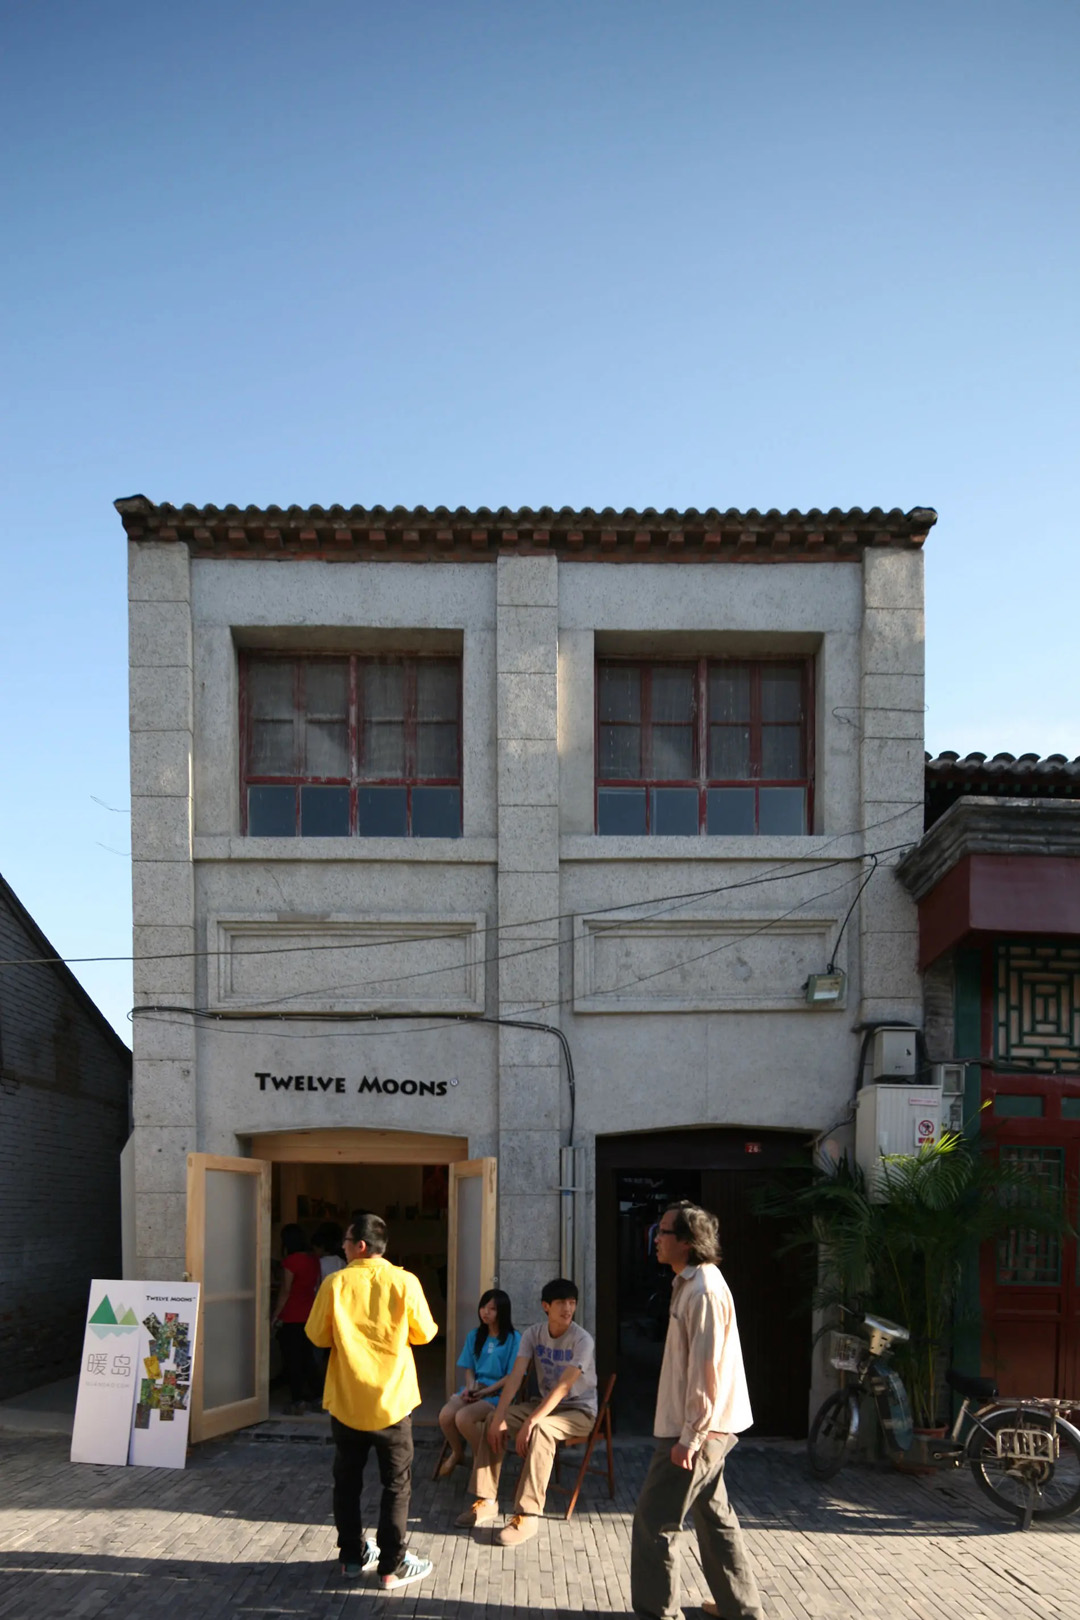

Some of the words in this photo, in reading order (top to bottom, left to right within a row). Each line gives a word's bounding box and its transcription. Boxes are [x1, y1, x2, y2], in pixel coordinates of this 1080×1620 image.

[254, 1072, 346, 1093] TWELVE
[358, 1075, 448, 1096] MOONS
[87, 1353, 131, 1377] 暖岛
